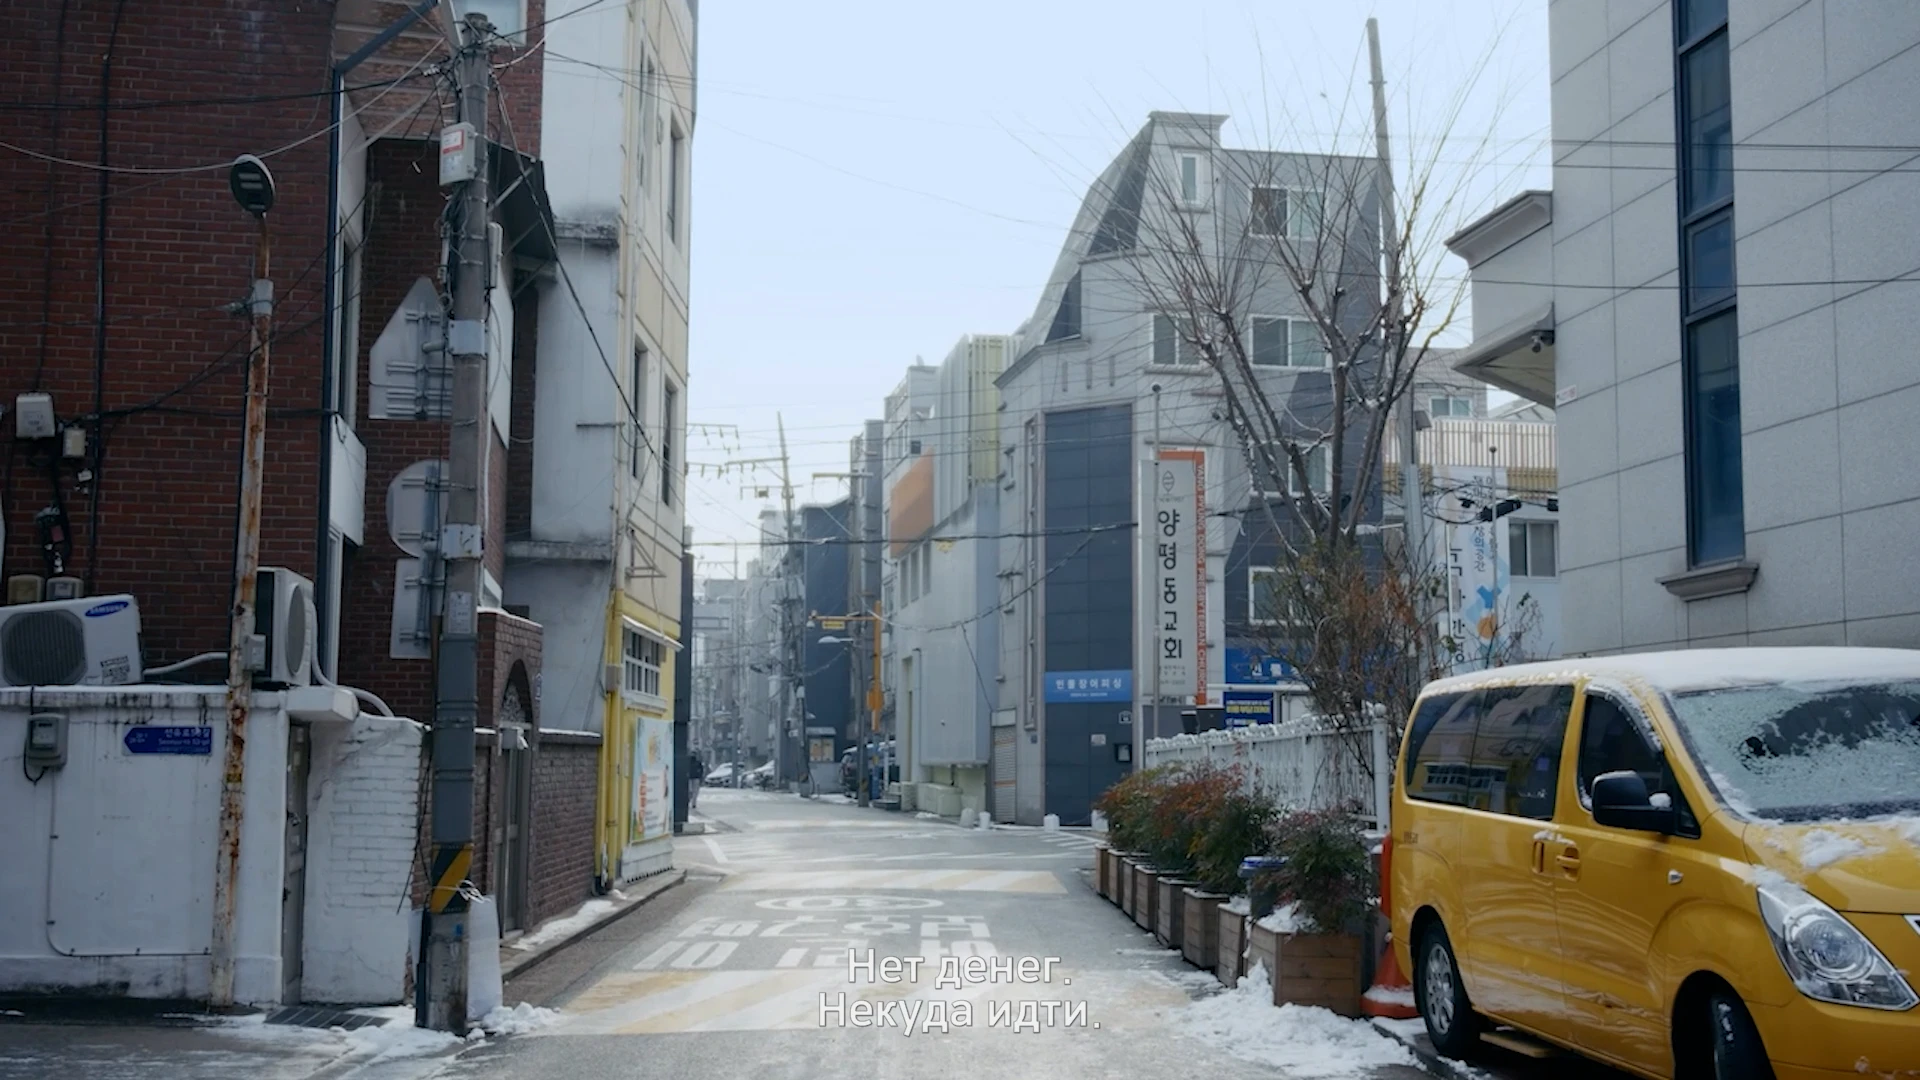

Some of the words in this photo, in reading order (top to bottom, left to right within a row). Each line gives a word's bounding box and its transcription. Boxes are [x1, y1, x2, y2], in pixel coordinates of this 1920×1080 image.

[1197, 463, 1205, 491] YANG
[1197, 494, 1205, 530] PYUNG
[1197, 534, 1206, 564] DONG
[1157, 509, 1182, 659] 양평동교회
[1197, 568, 1206, 645] PRESBYTERIAN
[1198, 648, 1207, 694] CHURCH
